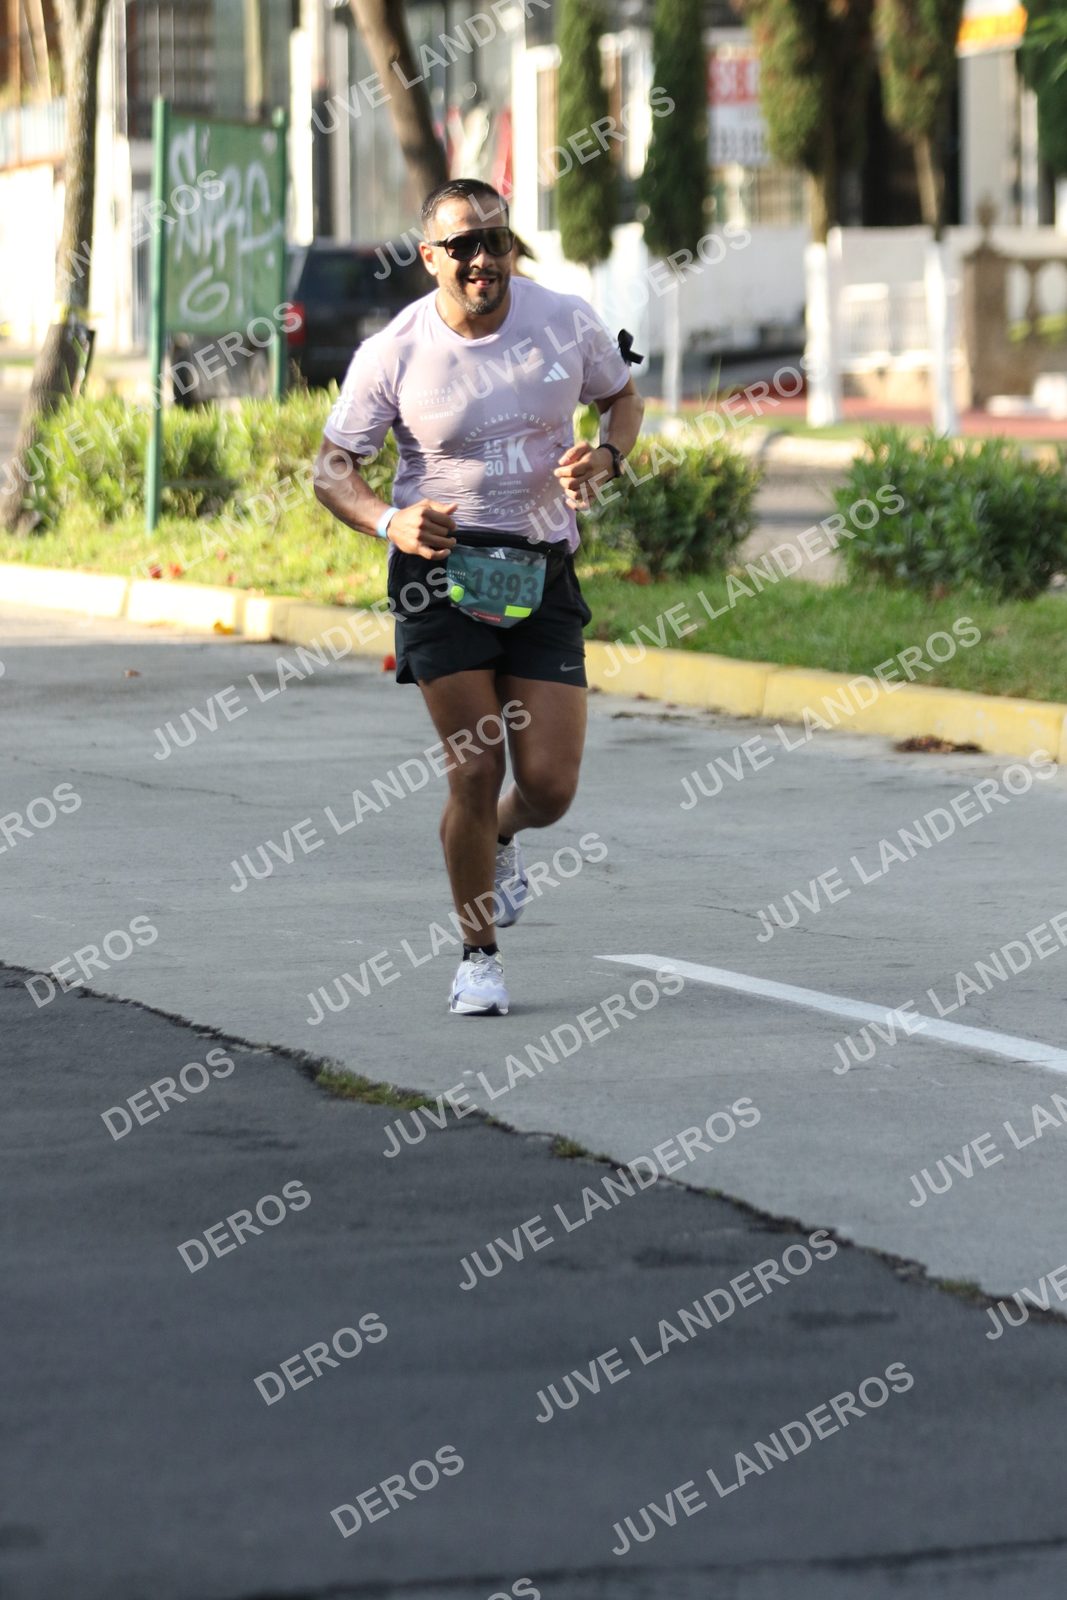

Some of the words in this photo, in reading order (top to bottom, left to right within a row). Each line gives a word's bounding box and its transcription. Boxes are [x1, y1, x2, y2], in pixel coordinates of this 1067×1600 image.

[483, 439, 502, 454] 15
[507, 436, 533, 474] K
[485, 459, 504, 476] 30
[472, 567, 539, 604] 1893
